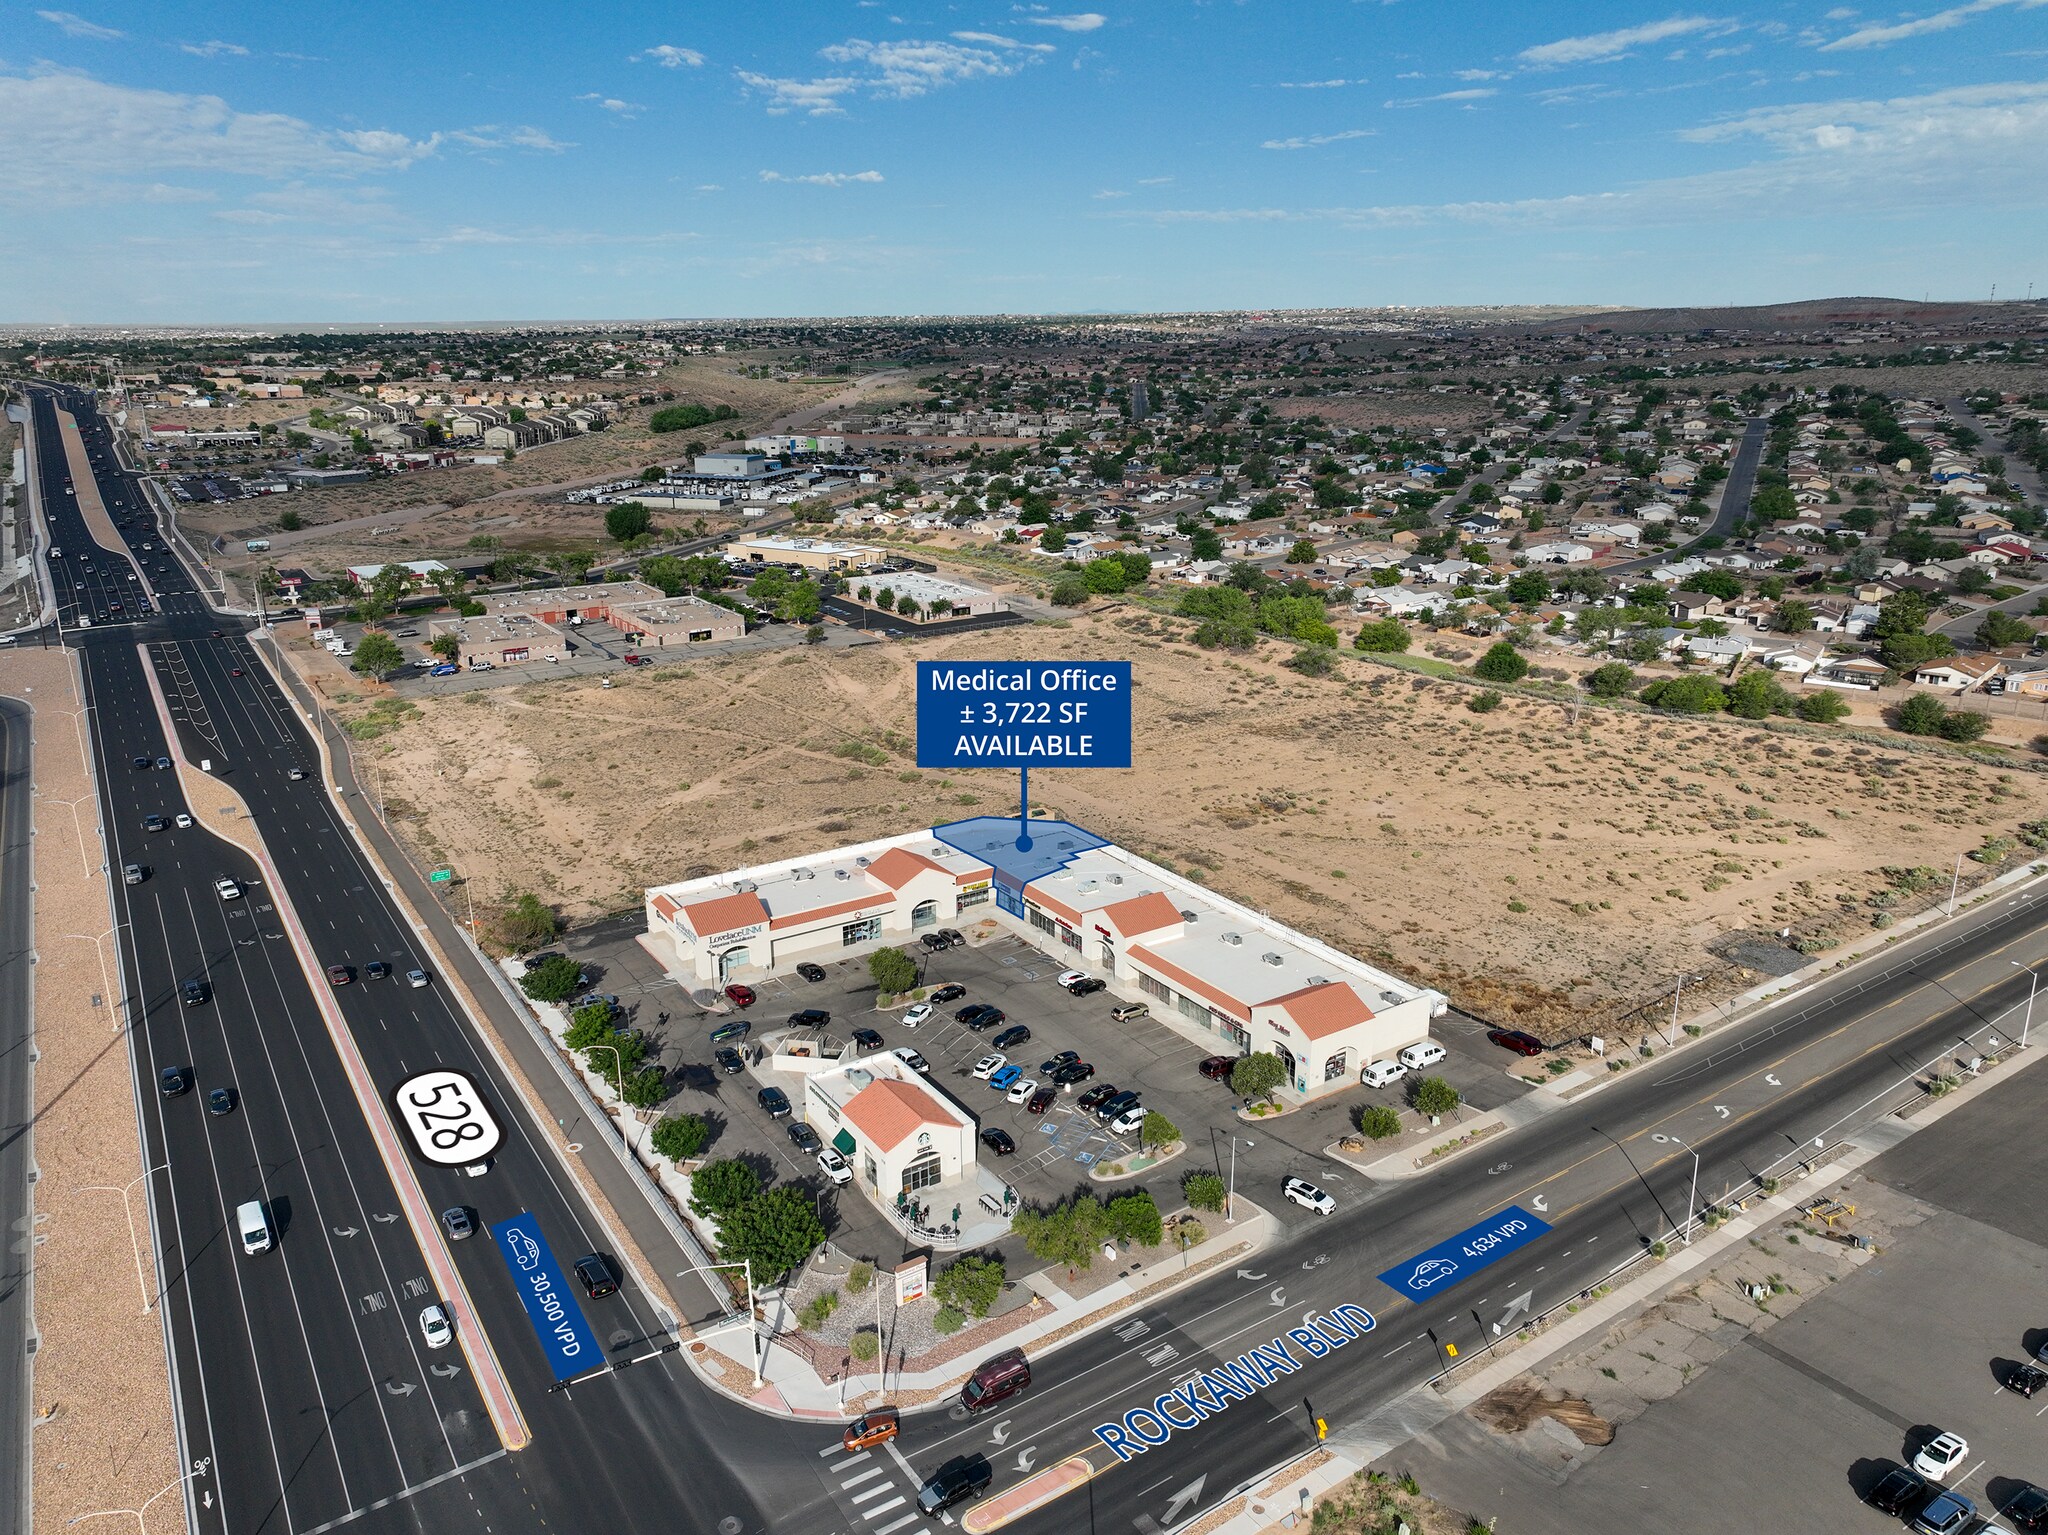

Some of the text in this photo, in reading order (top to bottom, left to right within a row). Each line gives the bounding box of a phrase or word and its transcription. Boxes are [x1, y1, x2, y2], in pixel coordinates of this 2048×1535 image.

[229, 909, 246, 919] ONLY
[256, 903, 273, 914] ONLY
[401, 1276, 429, 1300] ONLY
[359, 1291, 387, 1316] ONLY
[1112, 1317, 1151, 1342] ONLY
[1139, 1341, 1180, 1367] ONLY
